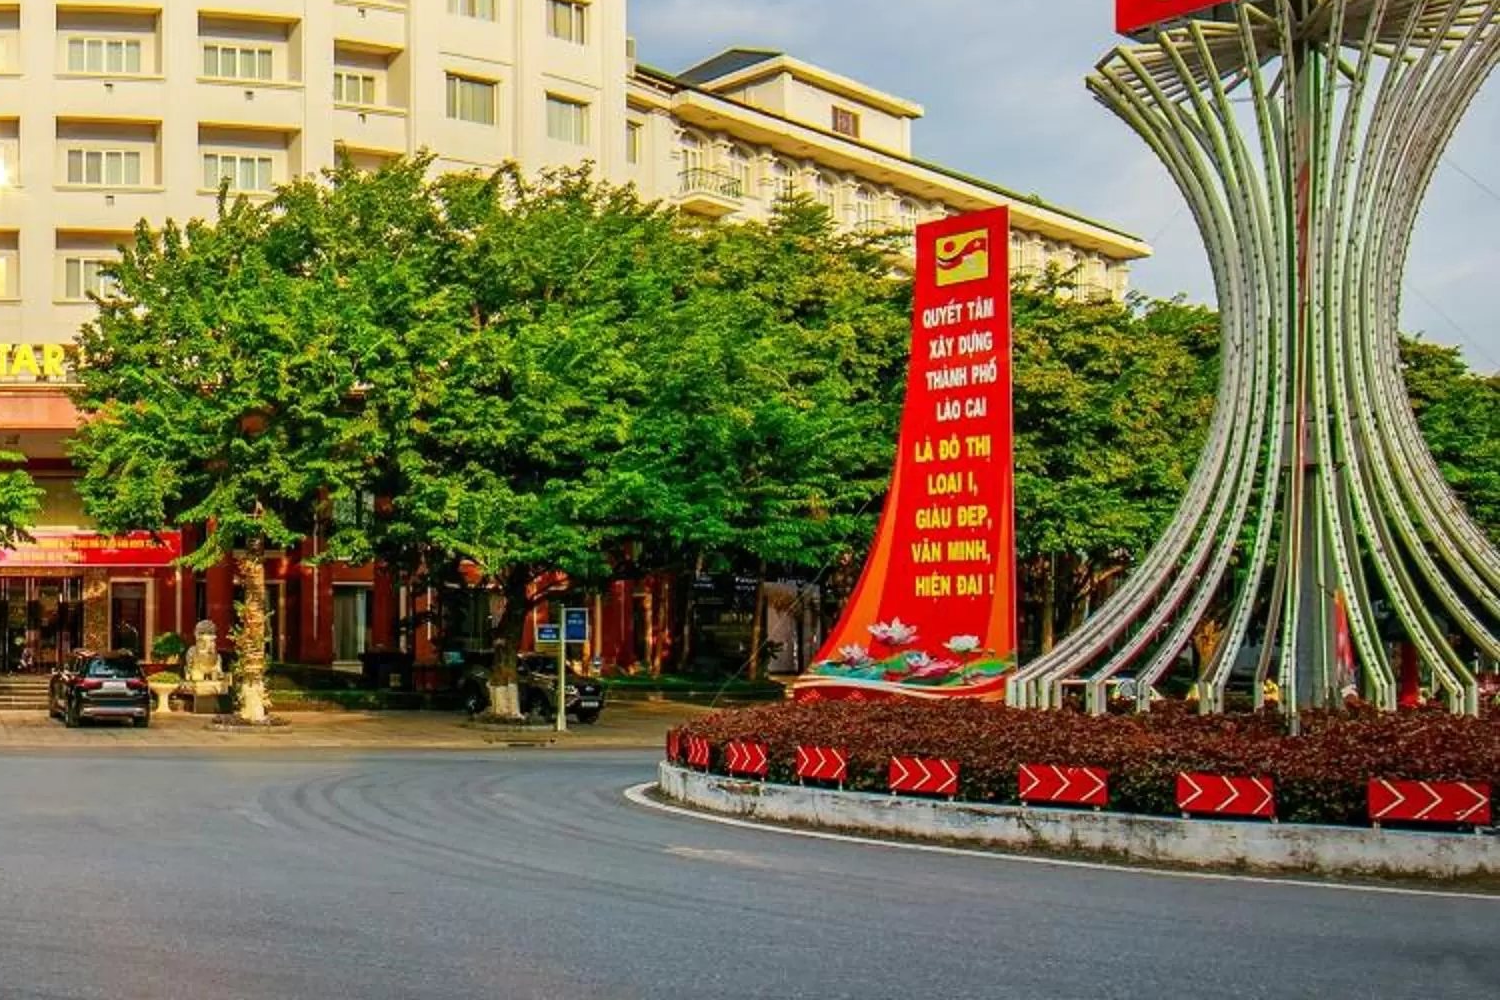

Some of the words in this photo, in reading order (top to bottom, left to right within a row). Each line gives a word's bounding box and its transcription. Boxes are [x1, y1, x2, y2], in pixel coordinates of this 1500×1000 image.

[923, 298, 963, 329] QUYẾT
[967, 296, 995, 321] TÂM
[929, 334, 955, 360] XÂY
[958, 329, 993, 358] DỰNG
[925, 364, 967, 391] THÀNH
[971, 356, 997, 384] PHỐ
[936, 396, 960, 422] LÀO
[965, 396, 987, 418] CAI
[915, 434, 934, 462] LÀ
[939, 432, 960, 460] ĐÔ
[965, 434, 991, 463] THỊ
[928, 472, 962, 499] LOẠI
[915, 503, 951, 529] GIÀU
[911, 538, 941, 563] VĂN
[947, 540, 991, 564] MINH,
[915, 570, 951, 604] HIỆN
